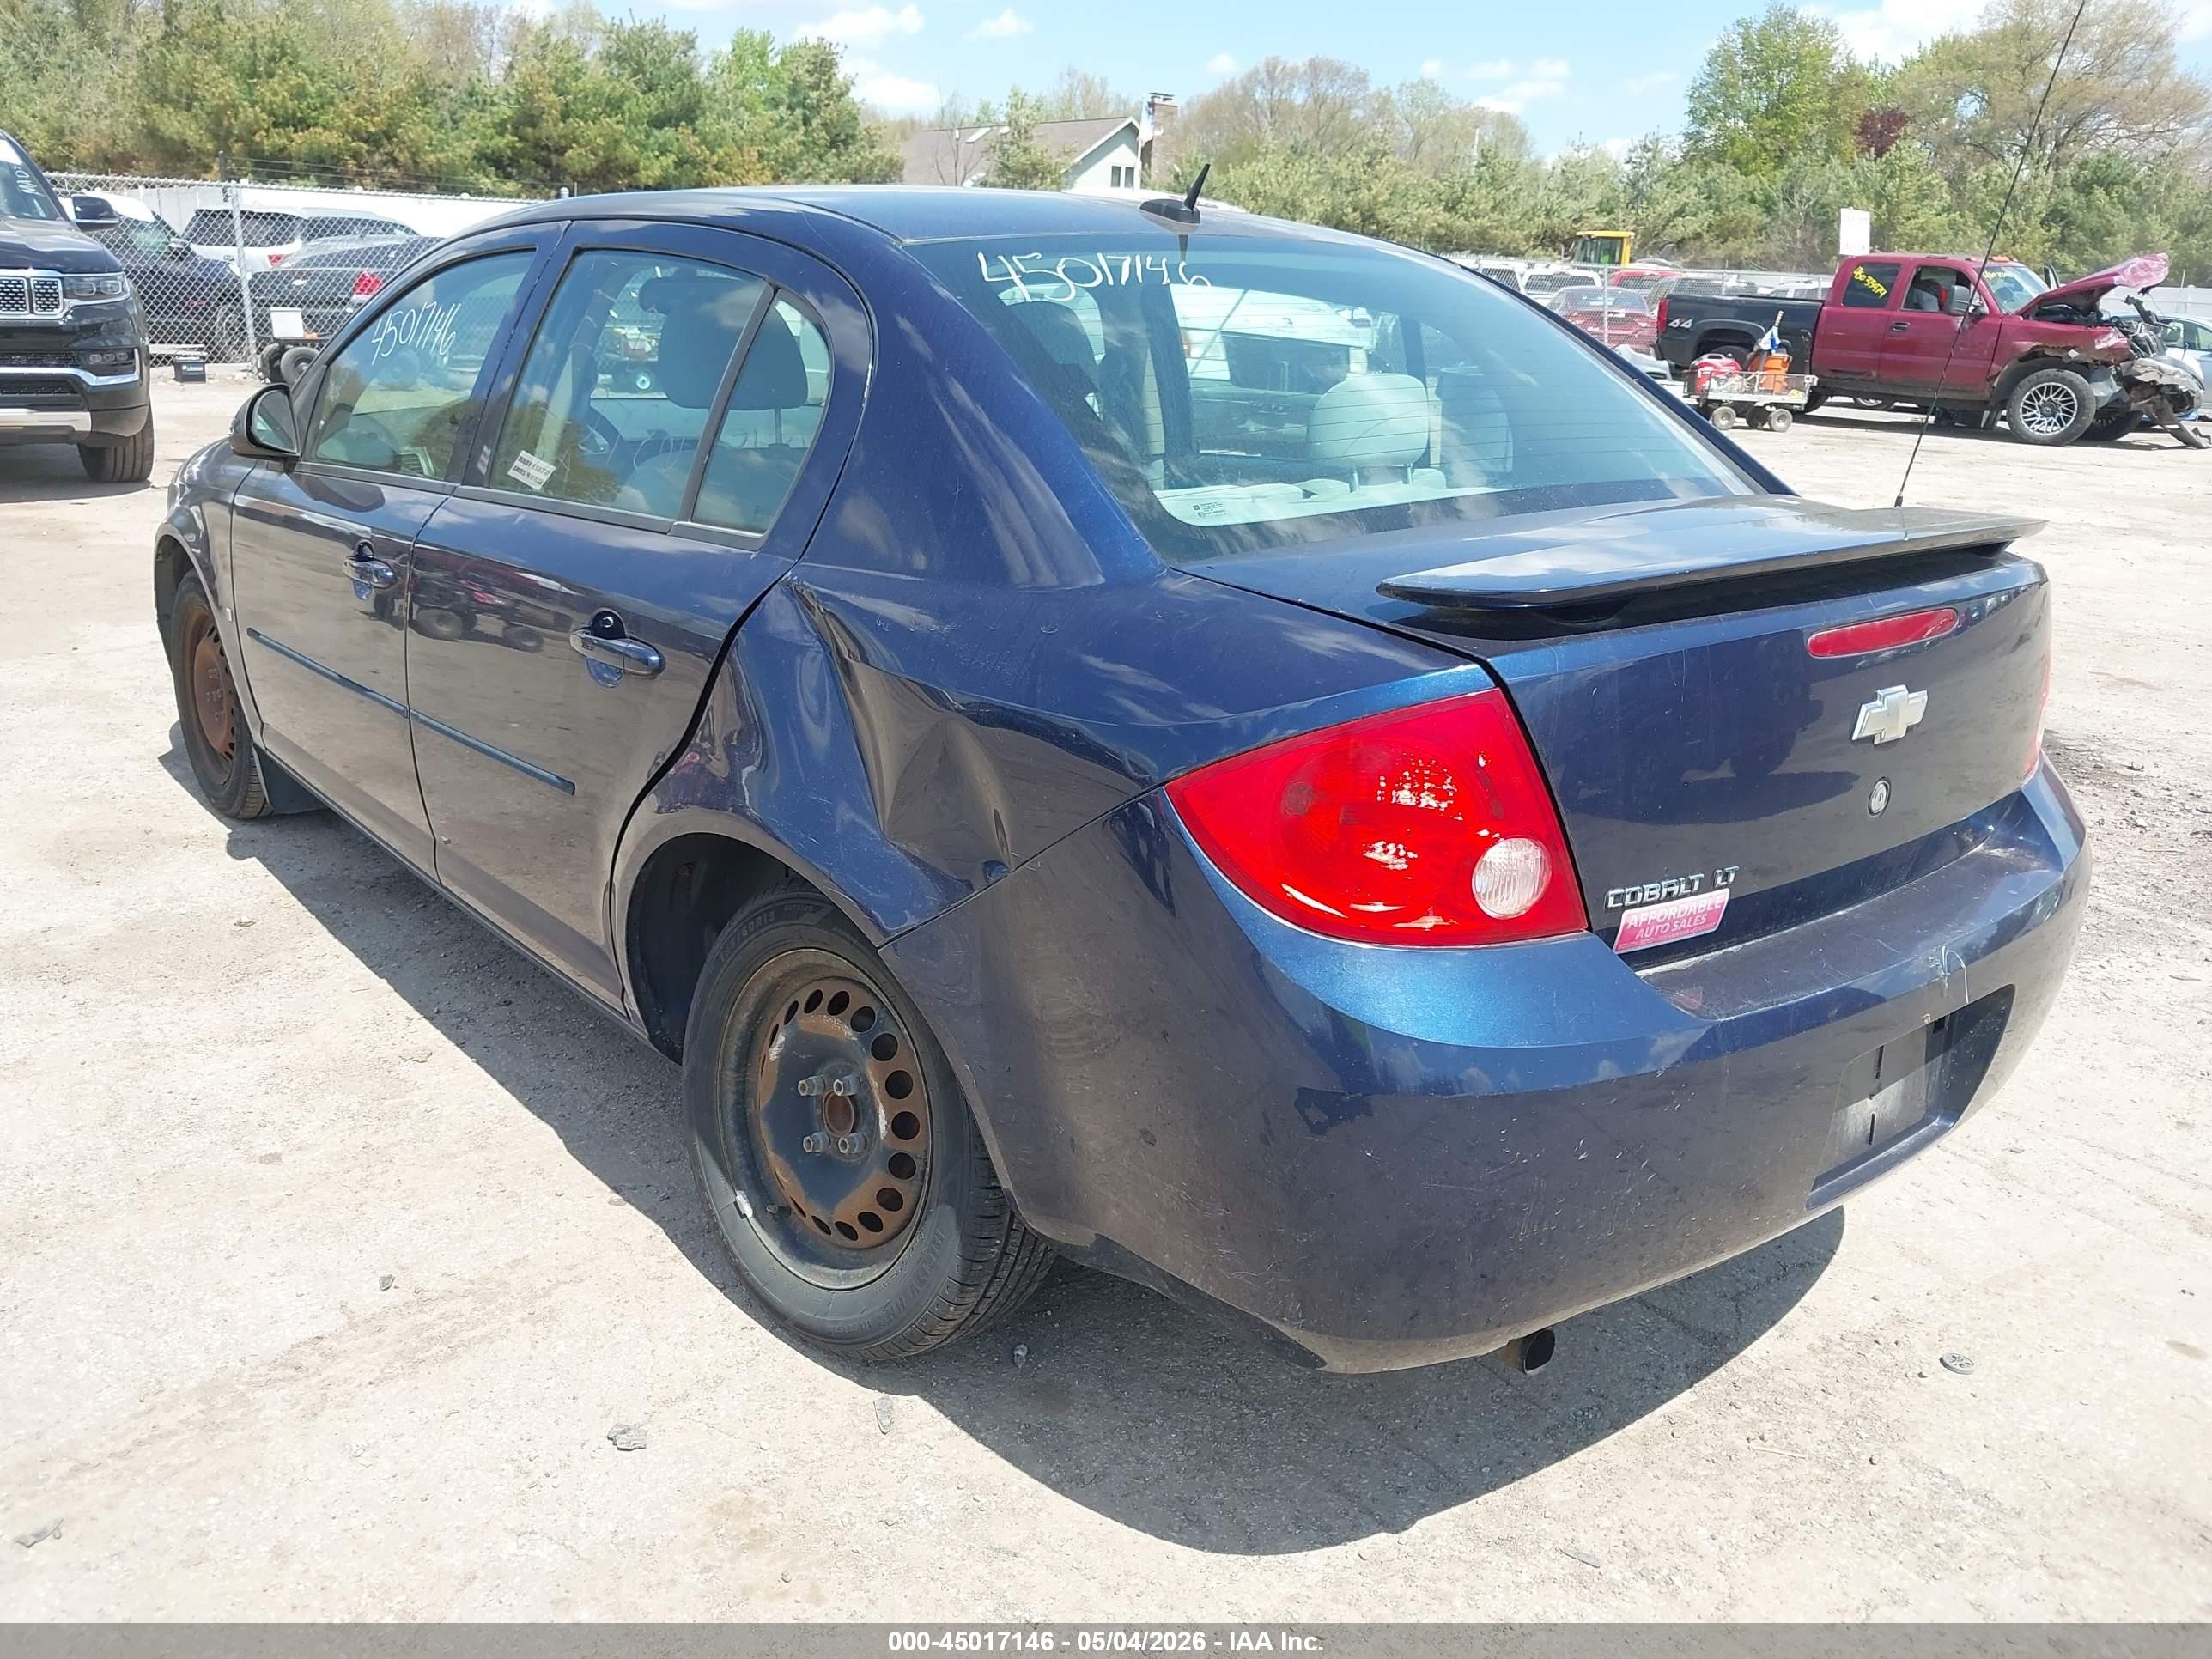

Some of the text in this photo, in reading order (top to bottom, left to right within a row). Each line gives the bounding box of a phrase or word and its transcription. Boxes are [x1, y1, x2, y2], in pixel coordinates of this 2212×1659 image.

[976, 250, 1213, 304] 45017146
[371, 301, 462, 366] 45017146
[1607, 866, 1740, 908] COBALT LT
[1628, 895, 1724, 928] AFFORDABLE
[1635, 922, 1670, 940] AUTO
[1670, 914, 1707, 933] SALES
